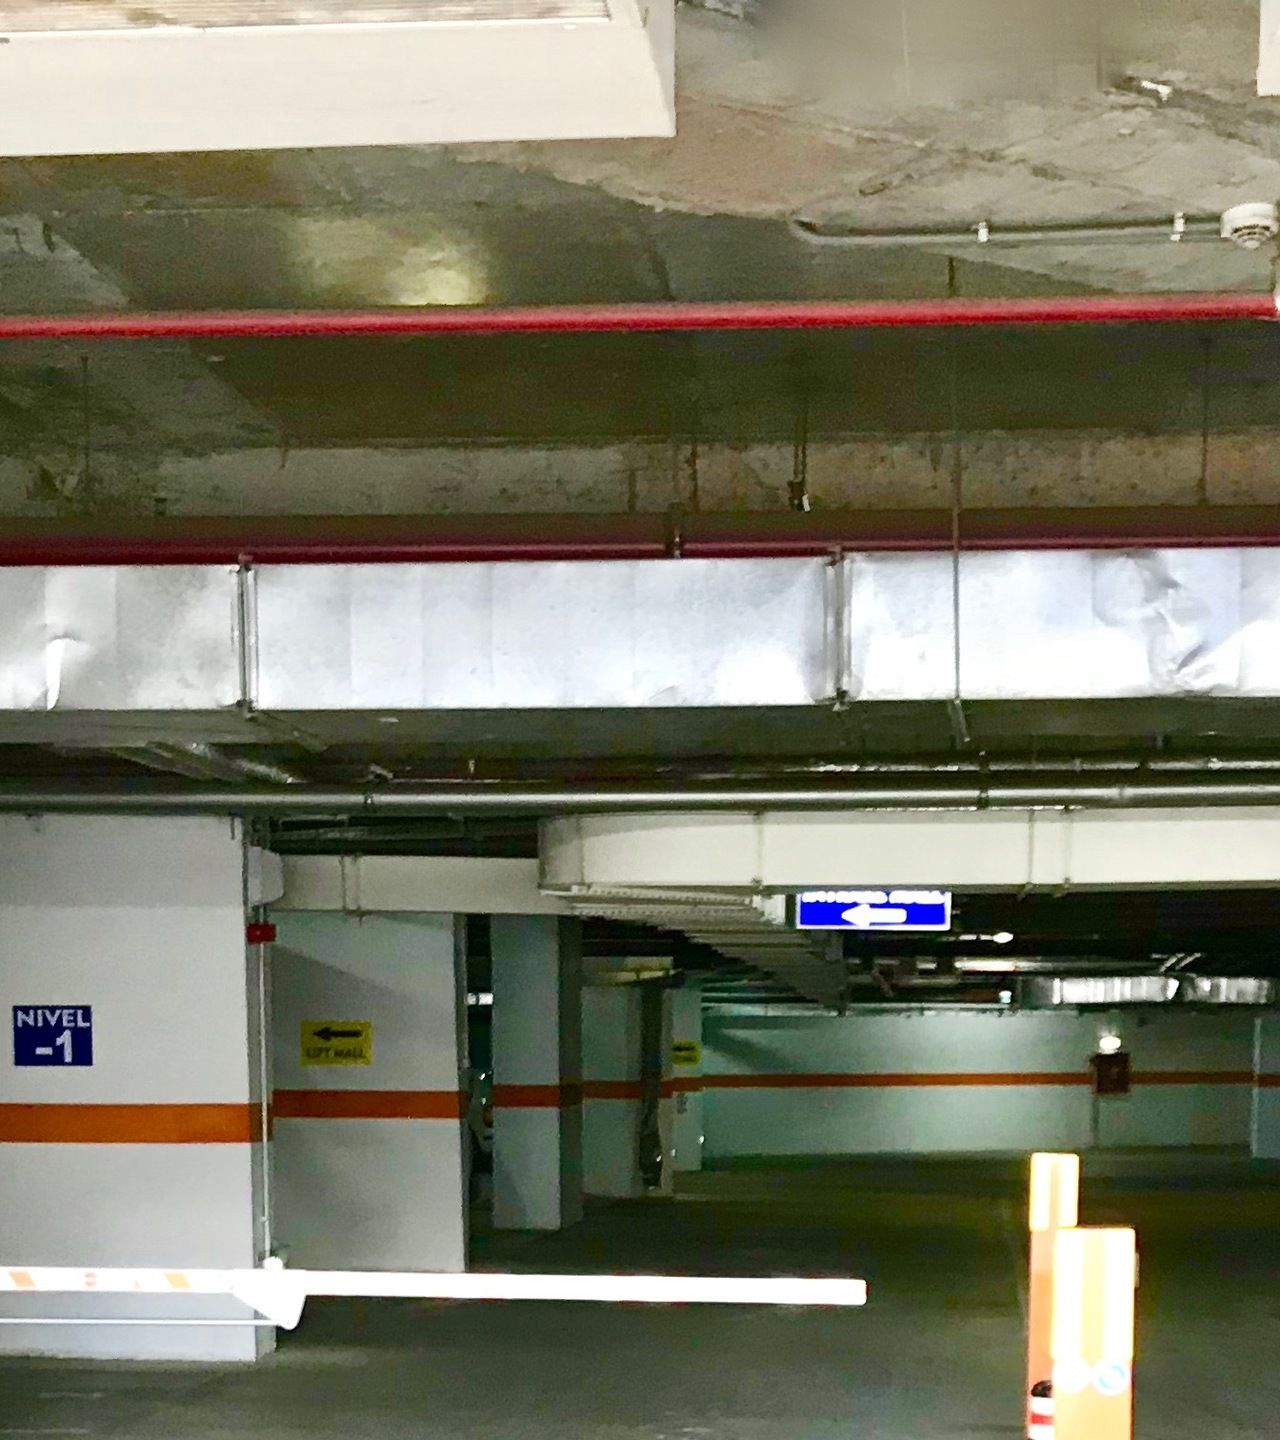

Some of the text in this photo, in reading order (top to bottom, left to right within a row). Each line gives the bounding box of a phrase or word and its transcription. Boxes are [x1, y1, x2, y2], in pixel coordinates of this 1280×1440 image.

[17, 1009, 90, 1027] NIVEL
[35, 1028, 72, 1063] -1
[306, 1047, 367, 1059] LIFT MALL
